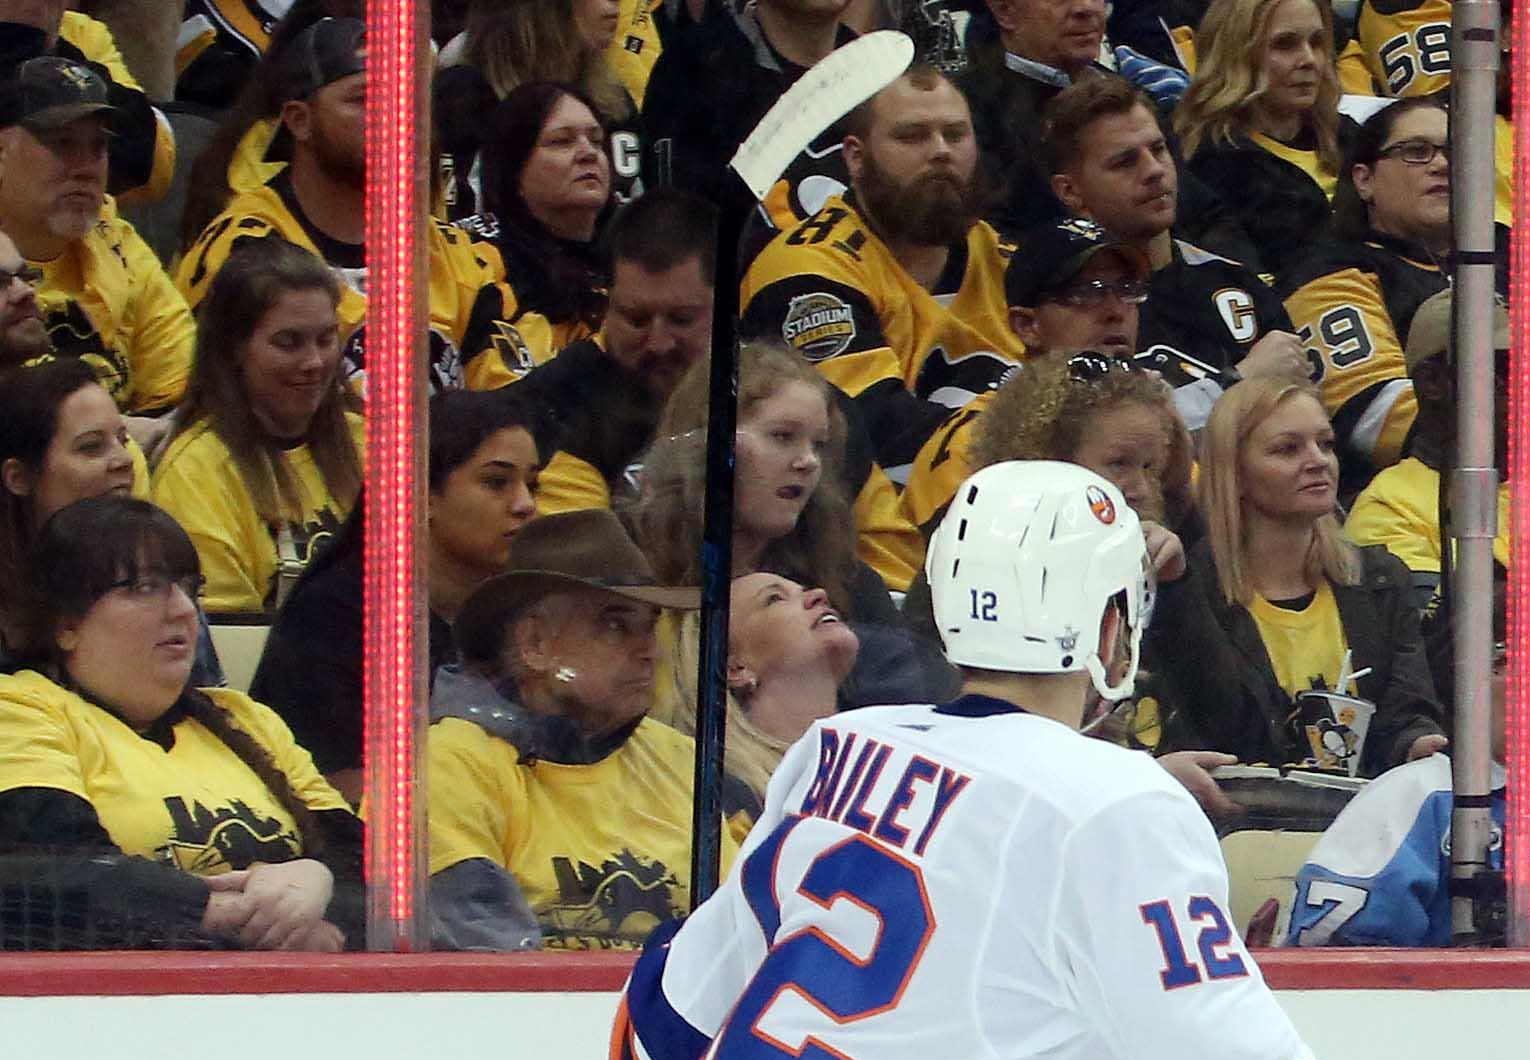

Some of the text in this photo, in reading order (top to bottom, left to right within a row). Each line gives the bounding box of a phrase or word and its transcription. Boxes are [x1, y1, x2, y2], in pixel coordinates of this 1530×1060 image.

[1379, 22, 1452, 97] 58
[786, 308, 851, 339] STADIUM
[1213, 288, 1258, 343] C
[970, 588, 998, 622] 12
[1138, 895, 1250, 991] 12
